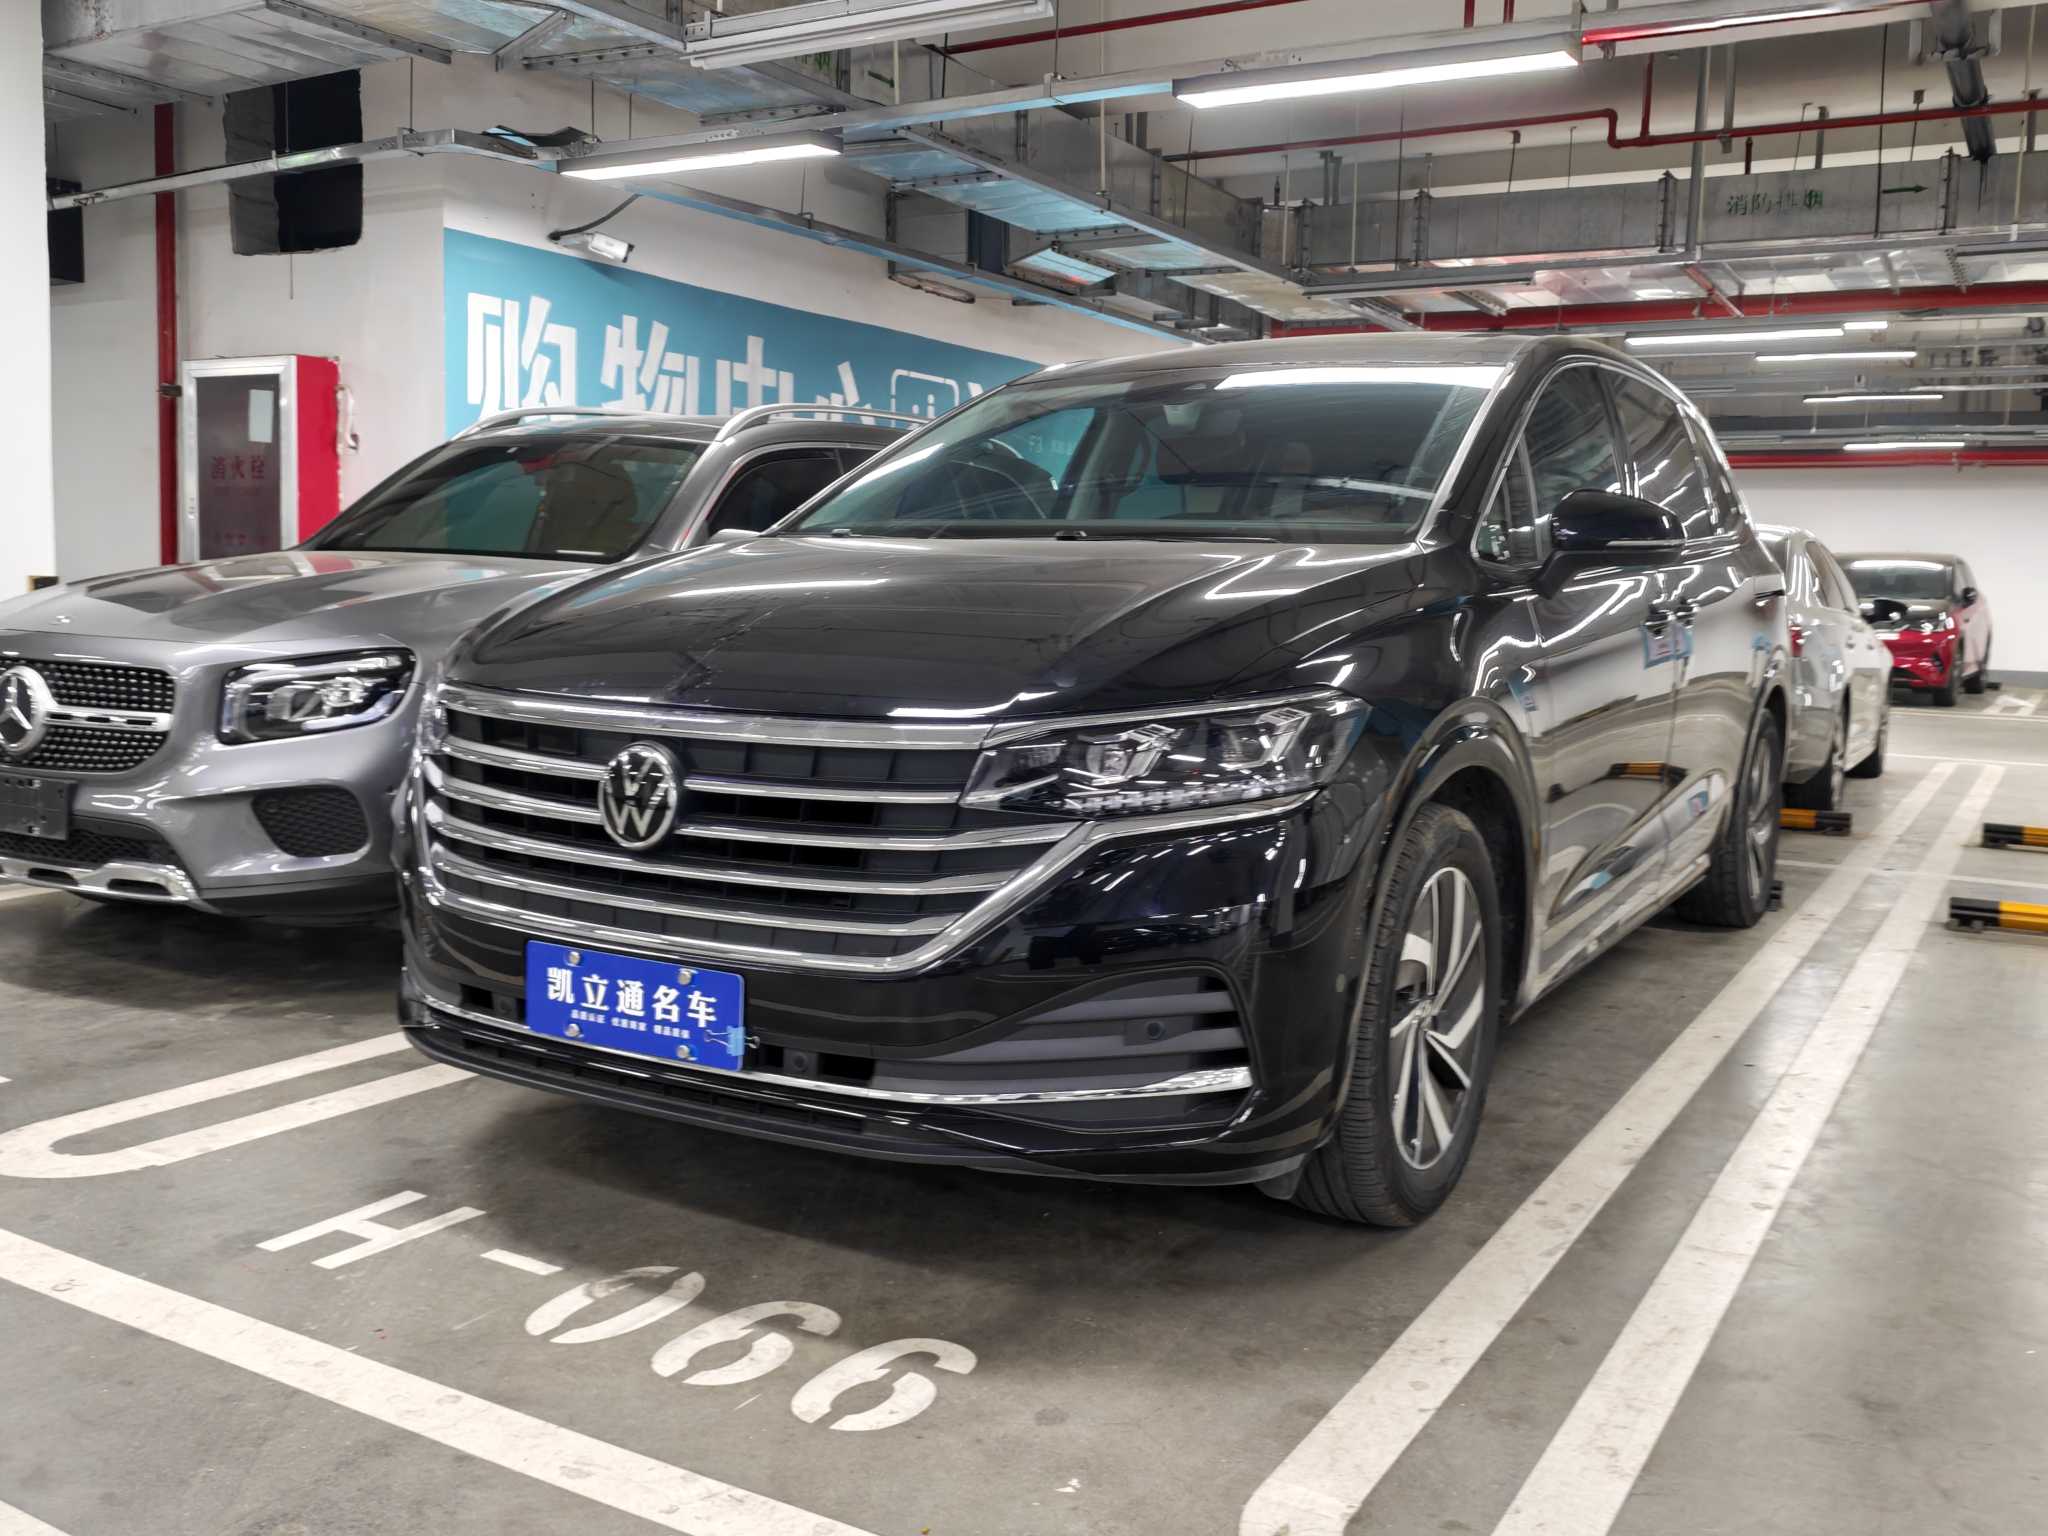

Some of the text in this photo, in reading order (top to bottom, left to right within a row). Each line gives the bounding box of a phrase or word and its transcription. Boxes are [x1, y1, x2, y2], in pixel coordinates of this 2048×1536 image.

[547, 967, 718, 1028] 凯立通名车
[256, 1190, 978, 1431] H-066
